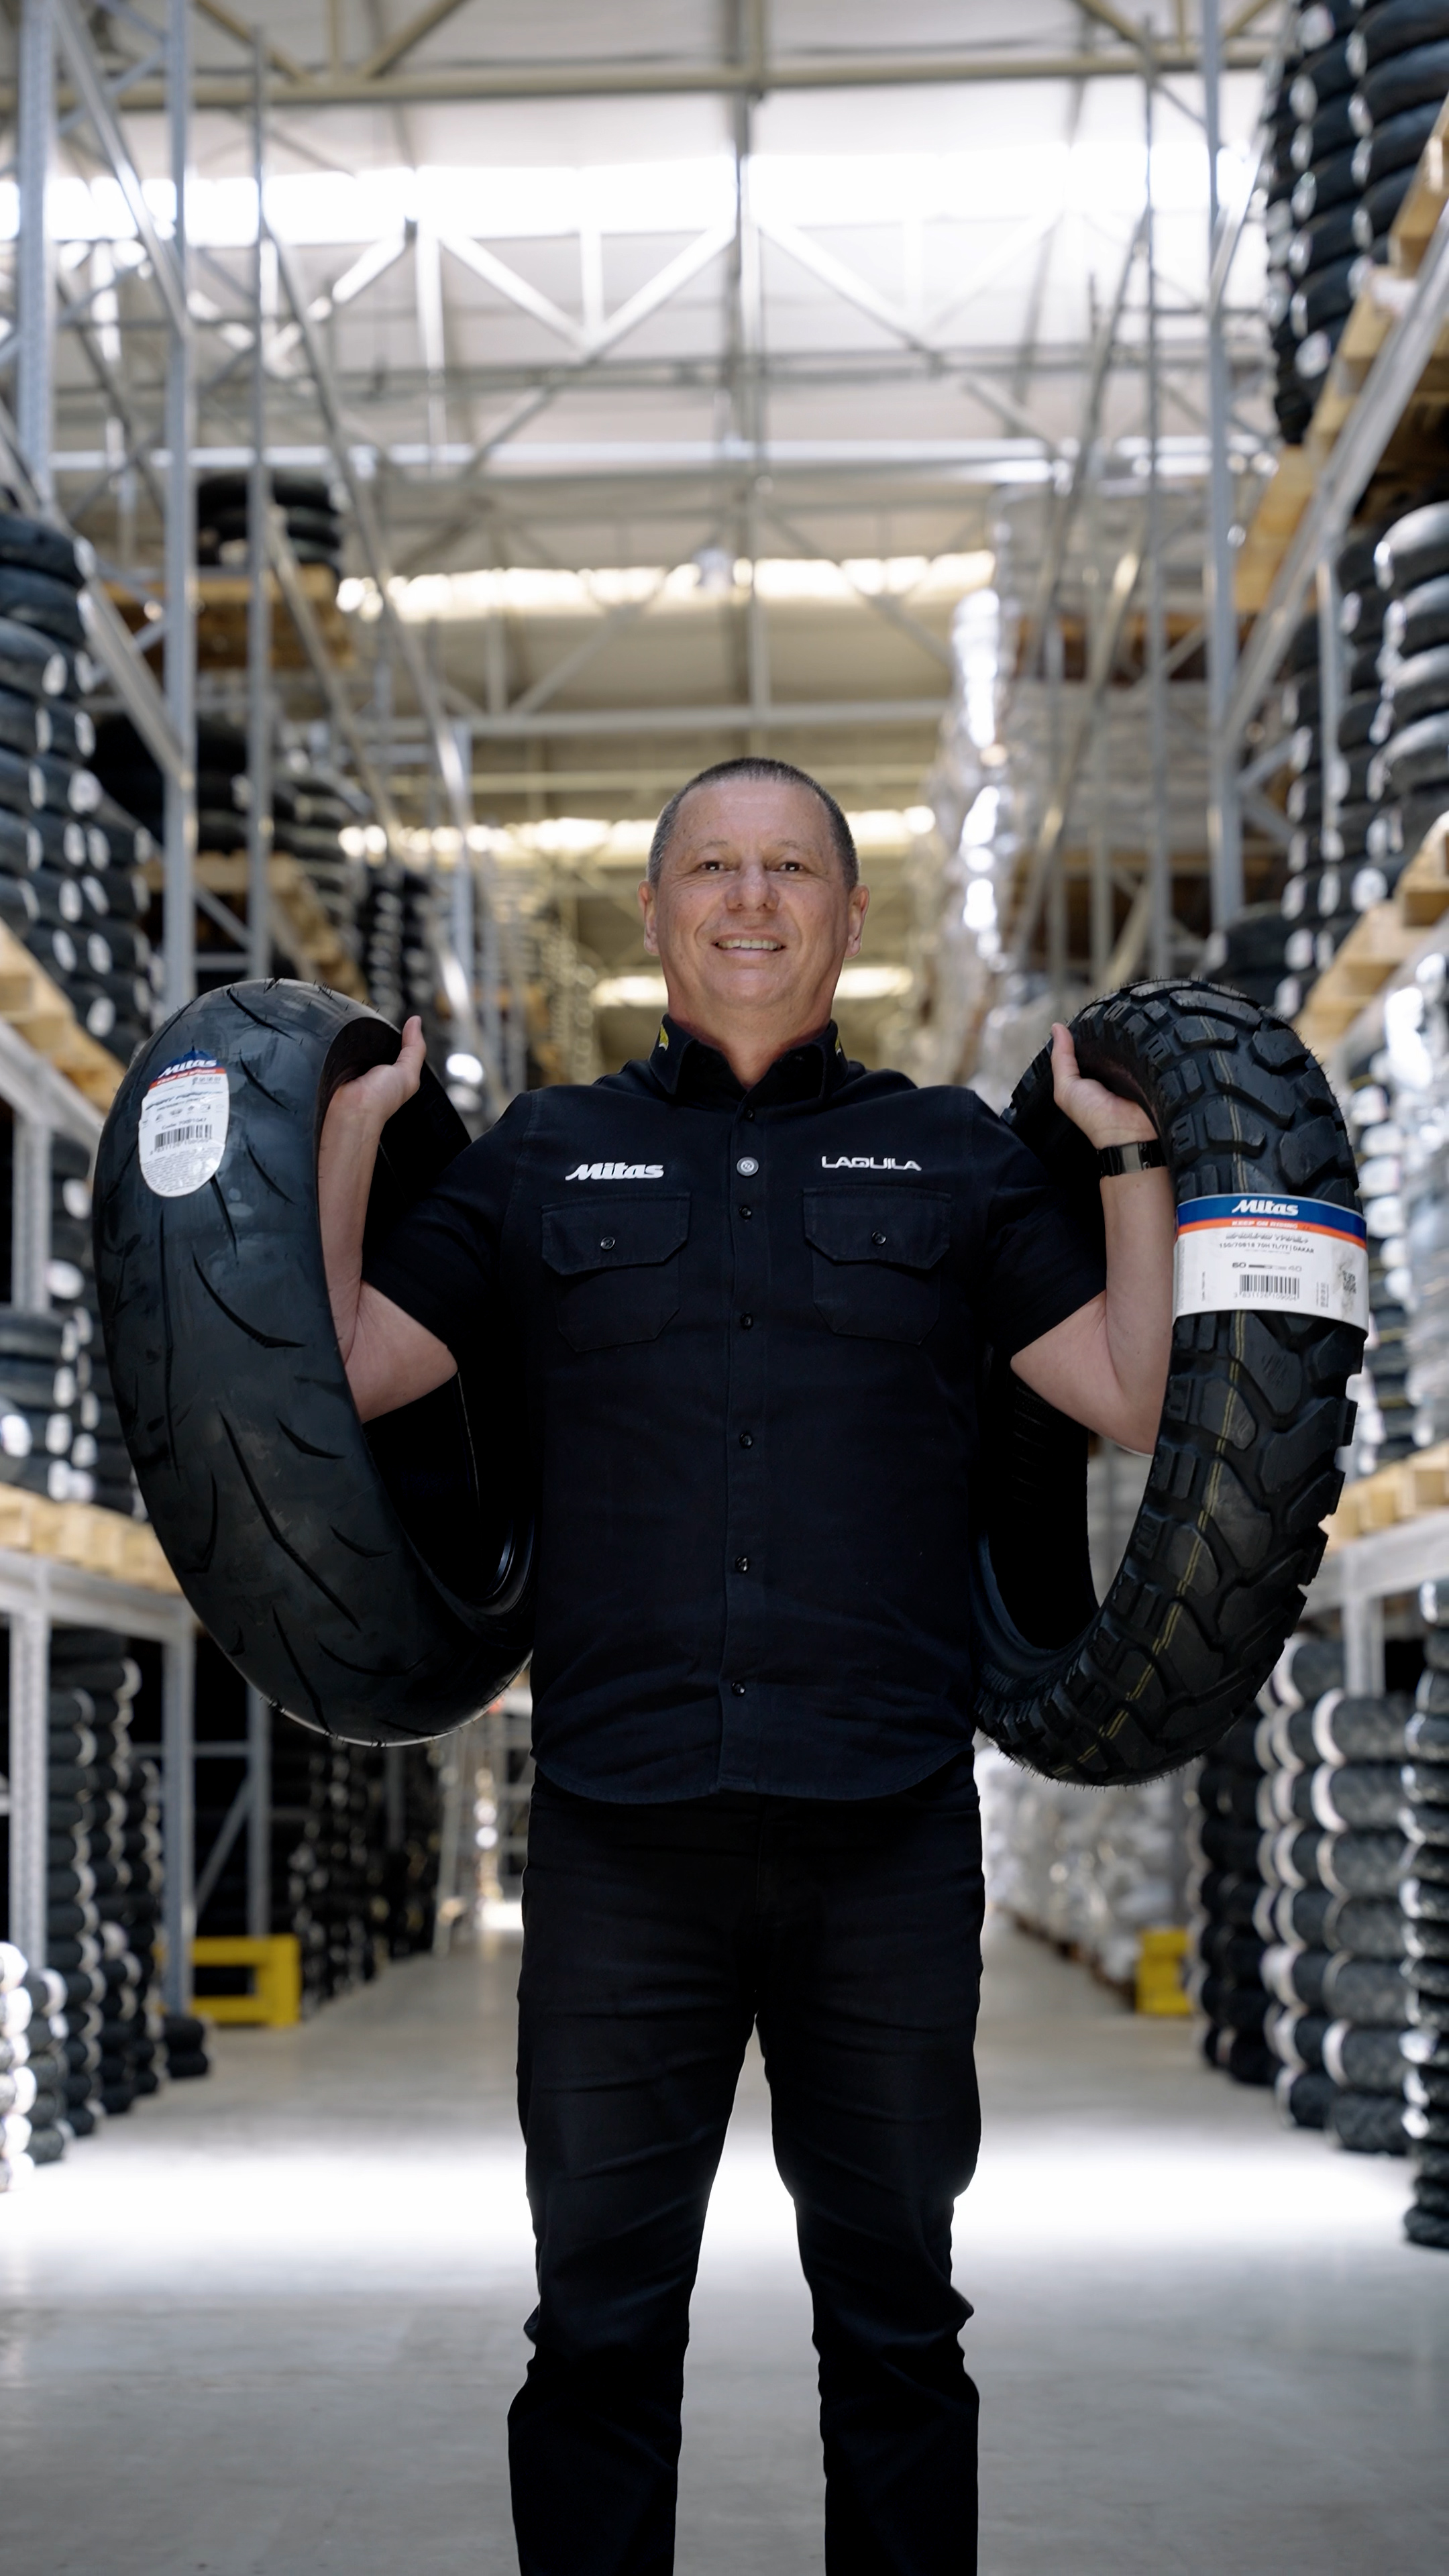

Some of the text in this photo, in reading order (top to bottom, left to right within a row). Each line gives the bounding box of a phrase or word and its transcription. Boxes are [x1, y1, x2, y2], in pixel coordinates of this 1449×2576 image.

[158, 1059, 217, 1079] Mitas
[822, 1156, 922, 1171] LAQUILA
[565, 1162, 664, 1181] Mitas
[1231, 1199, 1299, 1216] Mitas
[1269, 1221, 1298, 1229] RIDING
[1293, 1246, 1315, 1254] DAKAR
[1288, 1265, 1302, 1273] 40
